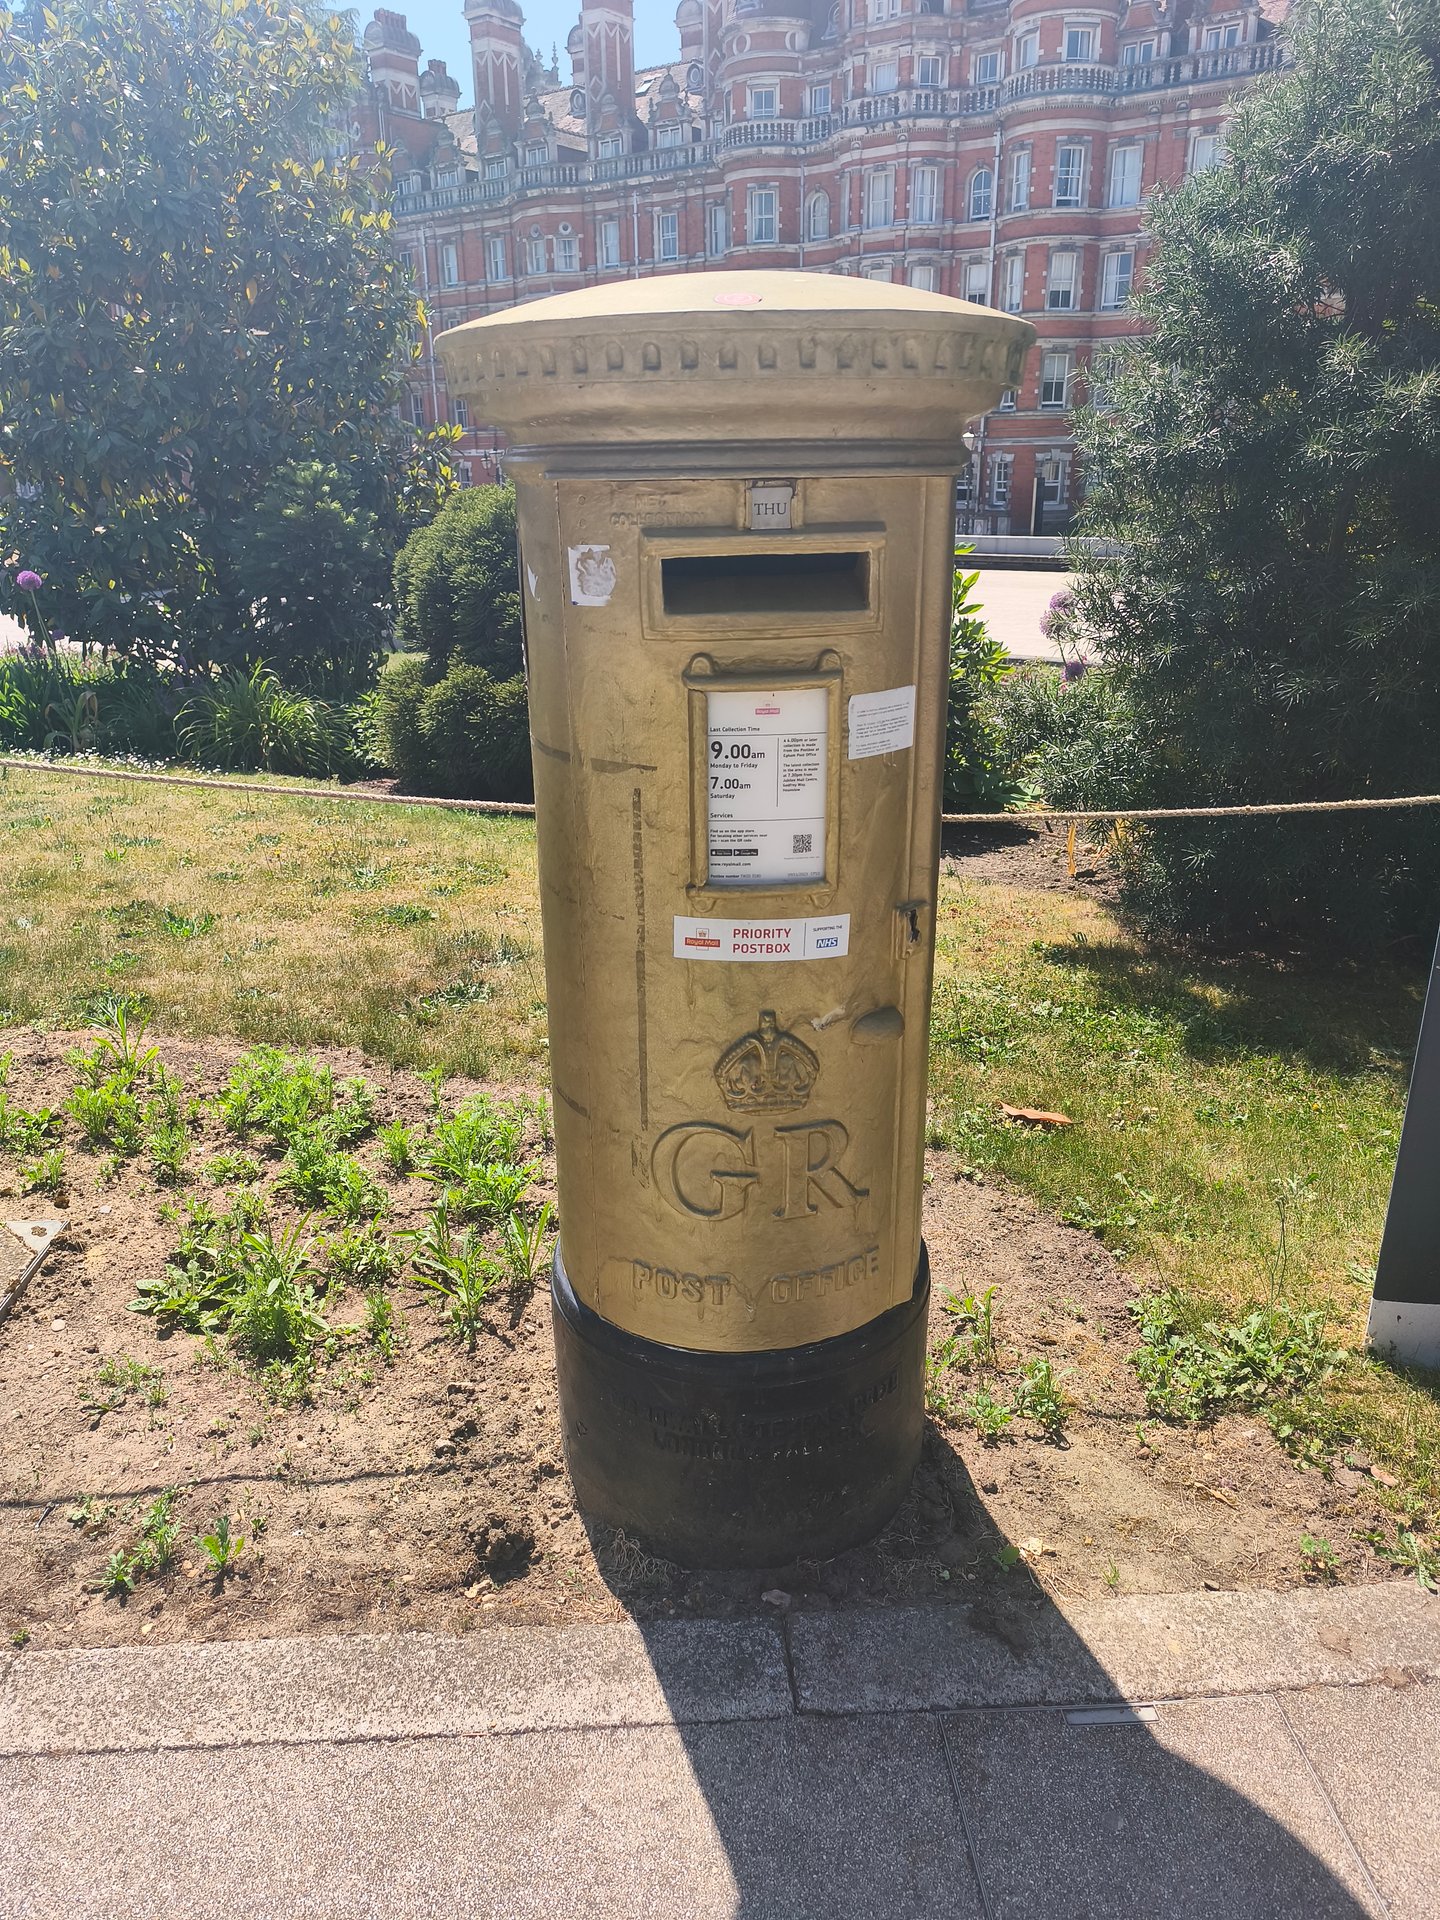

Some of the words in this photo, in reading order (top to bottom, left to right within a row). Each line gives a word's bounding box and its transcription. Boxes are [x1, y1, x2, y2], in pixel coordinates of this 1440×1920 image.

[753, 502, 787, 516] THU
[610, 511, 705, 527] COLLECTION
[711, 741, 765, 759] 9.00am
[710, 776, 751, 789] 7.00am
[733, 928, 791, 939] PRIORITY
[686, 938, 704, 946] Royal
[732, 943, 791, 953] POSTBOX
[817, 937, 838, 948] NHS
[651, 1119, 869, 1222] GR
[632, 1259, 730, 1305] POST
[770, 1245, 880, 1304] OFFICE
